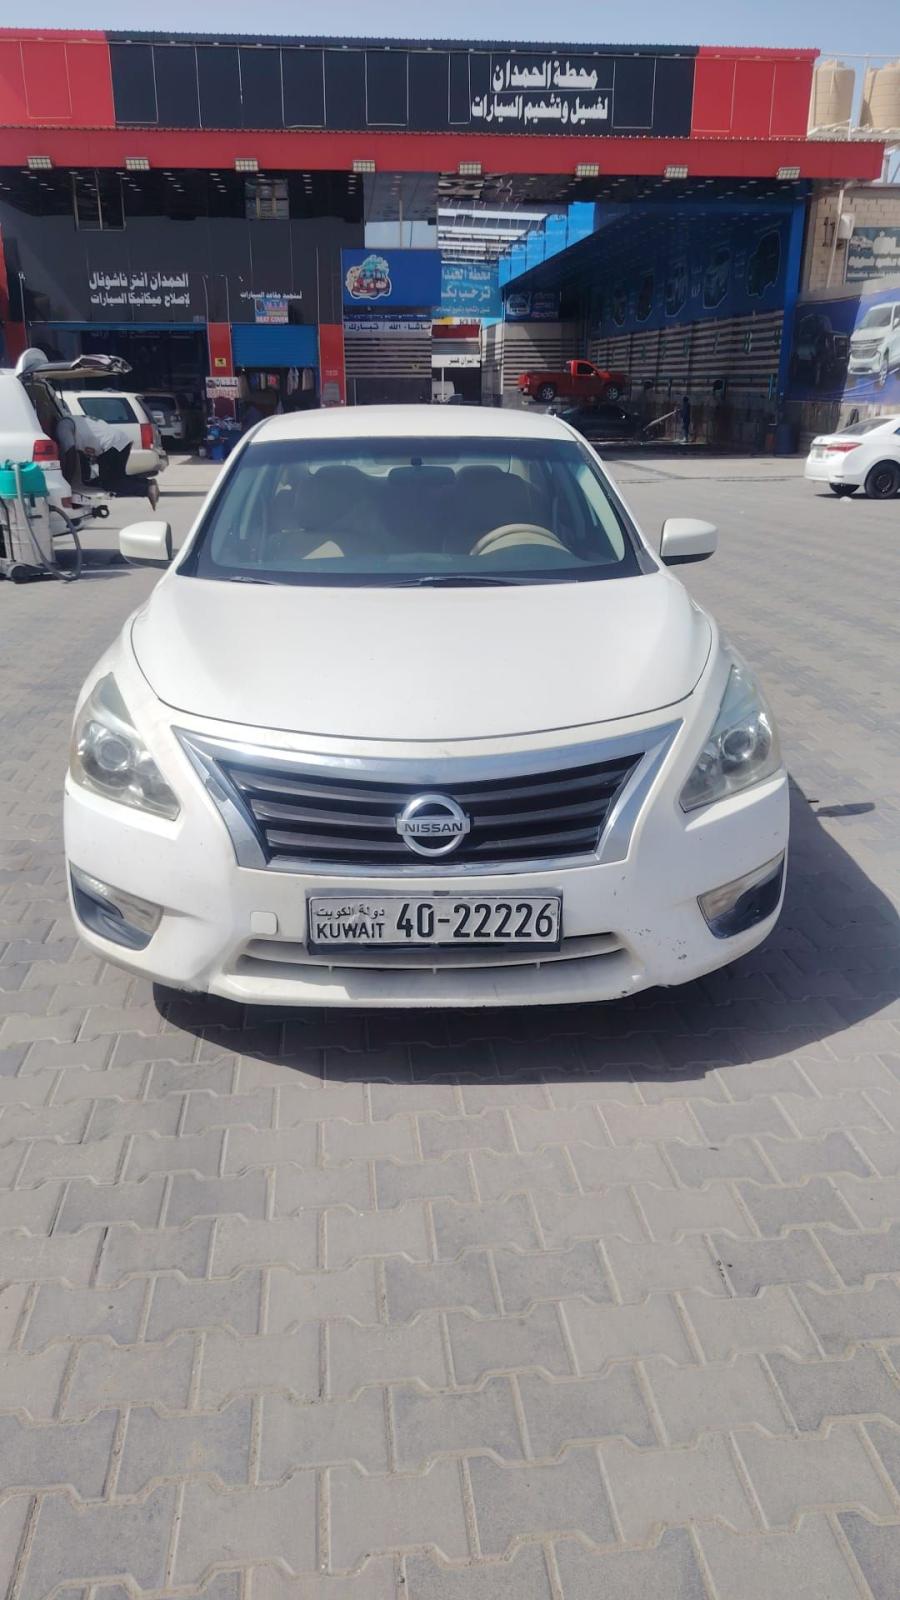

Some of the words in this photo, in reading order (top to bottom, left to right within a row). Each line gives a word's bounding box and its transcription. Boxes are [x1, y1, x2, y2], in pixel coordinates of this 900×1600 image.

[492, 59, 552, 91] الحمدان
[553, 60, 599, 90] محطة
[471, 94, 523, 123] السيارات
[524, 93, 569, 125] وتشحيم
[570, 96, 609, 125] لغسيل
[89, 272, 128, 290] ناشونال
[150, 272, 189, 290] الحمدان
[90, 292, 127, 307] السيارات
[128, 292, 162, 307] ميكانيكا
[404, 822, 463, 833] NISSAN
[314, 904, 356, 920] الكويت
[358, 903, 385, 918] دولة
[396, 902, 553, 938] 40-22226
[316, 922, 385, 939] KUWAIT
